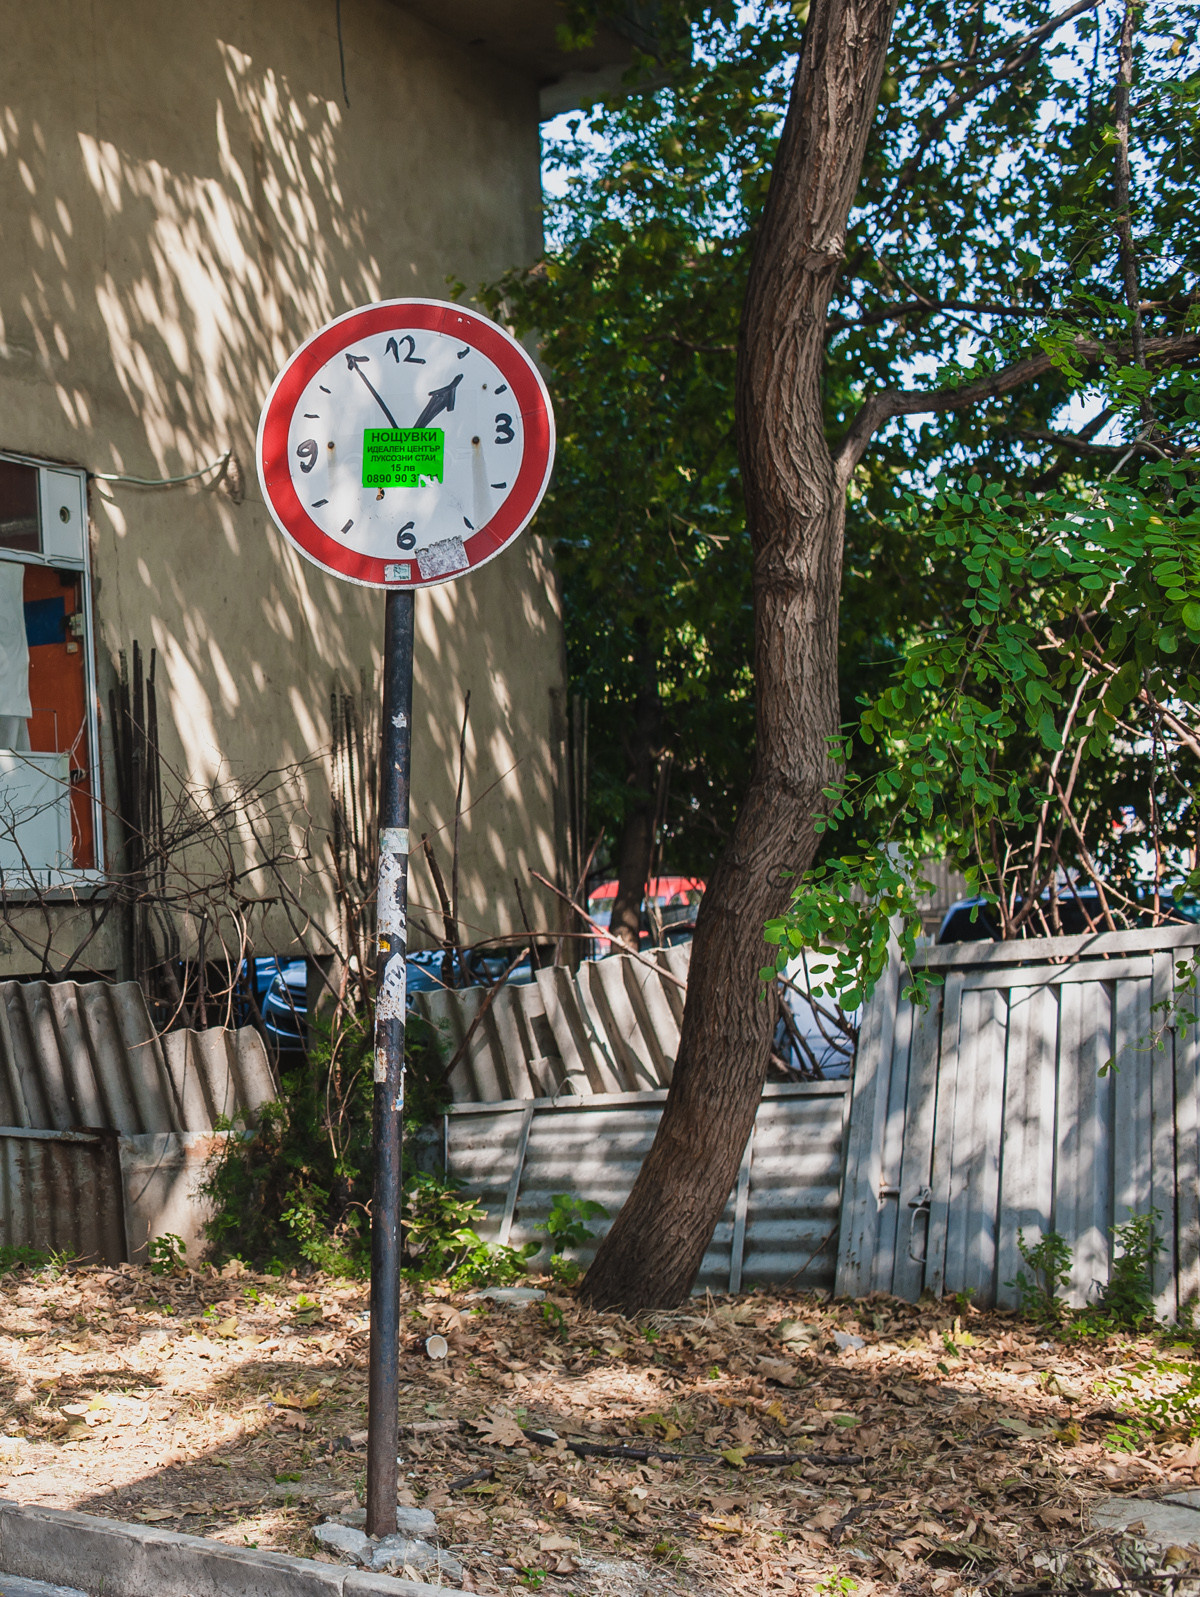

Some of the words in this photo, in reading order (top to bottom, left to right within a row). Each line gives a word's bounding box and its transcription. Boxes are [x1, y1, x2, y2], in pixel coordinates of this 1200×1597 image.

[383, 335, 427, 364] 12
[494, 413, 515, 444] 3
[371, 432, 437, 443] НОЩУВКИ
[407, 445, 441, 453] ЦЕНТЪР
[297, 438, 318, 473] 9
[415, 454, 436, 462] СТАИ
[391, 464, 401, 472] 15
[367, 474, 392, 483] 0890
[395, 474, 407, 483] 90
[396, 521, 416, 550] 6
